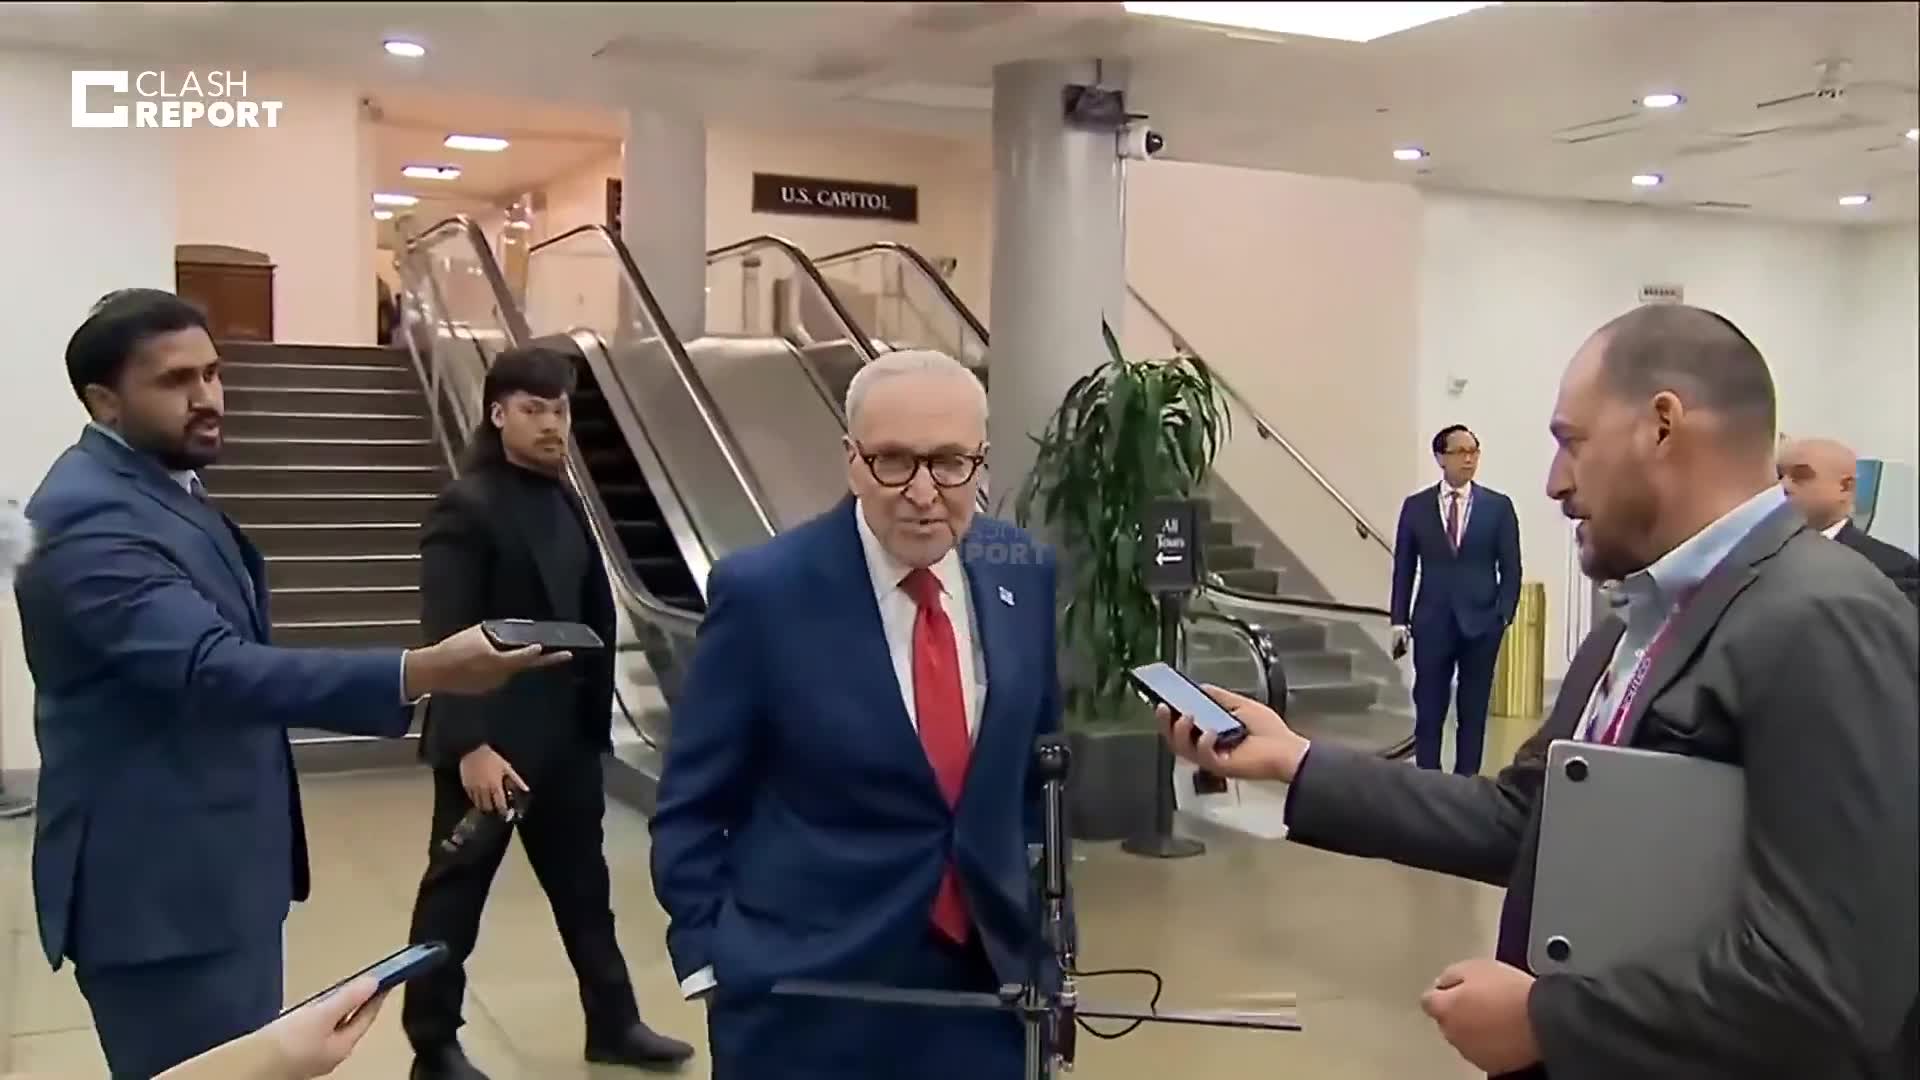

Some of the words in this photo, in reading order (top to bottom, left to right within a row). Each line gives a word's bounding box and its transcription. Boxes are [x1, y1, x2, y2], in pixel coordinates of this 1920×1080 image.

[781, 187, 813, 206] U.S.
[817, 190, 892, 210] CAPITOL
[1162, 518, 1179, 533] All
[1156, 533, 1185, 549] Tours
